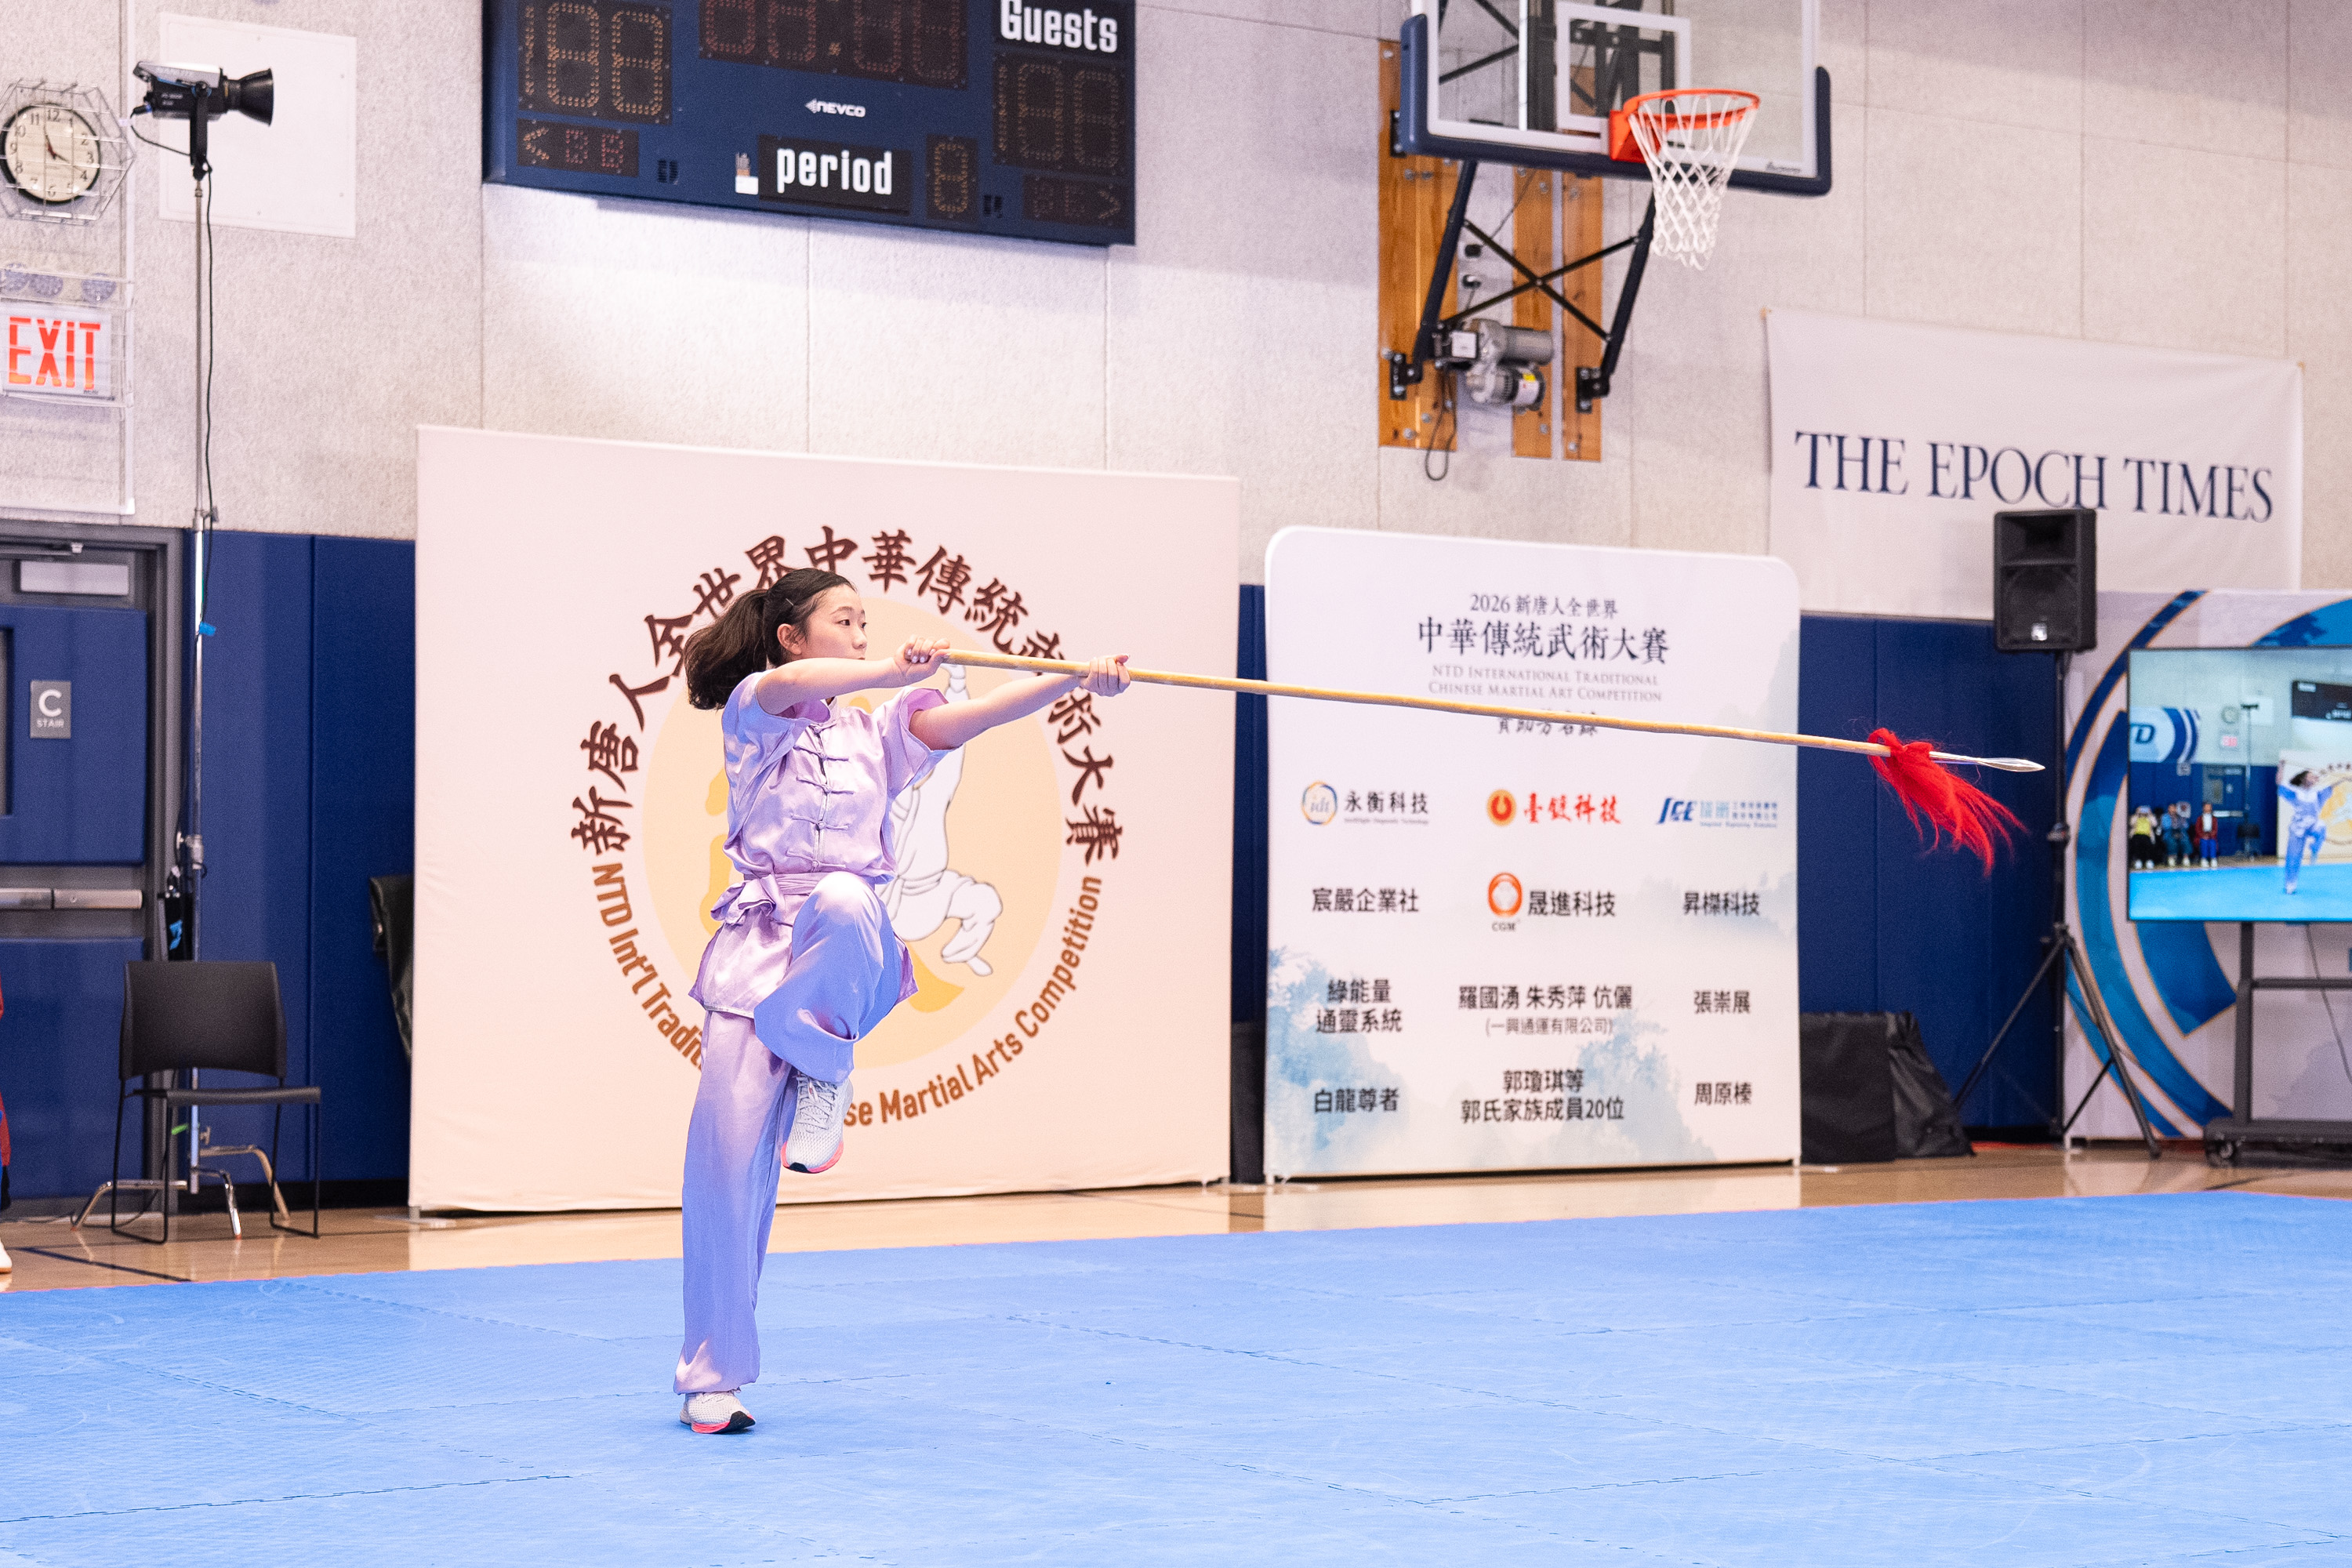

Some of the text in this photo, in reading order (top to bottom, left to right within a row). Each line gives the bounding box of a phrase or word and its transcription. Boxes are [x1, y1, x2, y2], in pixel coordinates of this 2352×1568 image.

[1000, 0, 1118, 53] Guests
[777, 147, 892, 195] period
[9, 316, 101, 390] EXIT
[1795, 431, 2273, 523] THE EPOCH TIMES
[1470, 593, 1619, 619] 2026 新唐人全世界
[1418, 616, 1668, 665] 中華傳統武術大賽
[36, 718, 64, 728] STAIR
[38, 689, 62, 717] C
[592, 862, 633, 927] NTD
[880, 876, 1102, 1124] Martial Arts Competition
[1316, 1007, 1403, 1034] 通靈系統
[1313, 1087, 1400, 1114] 白龍尊者
